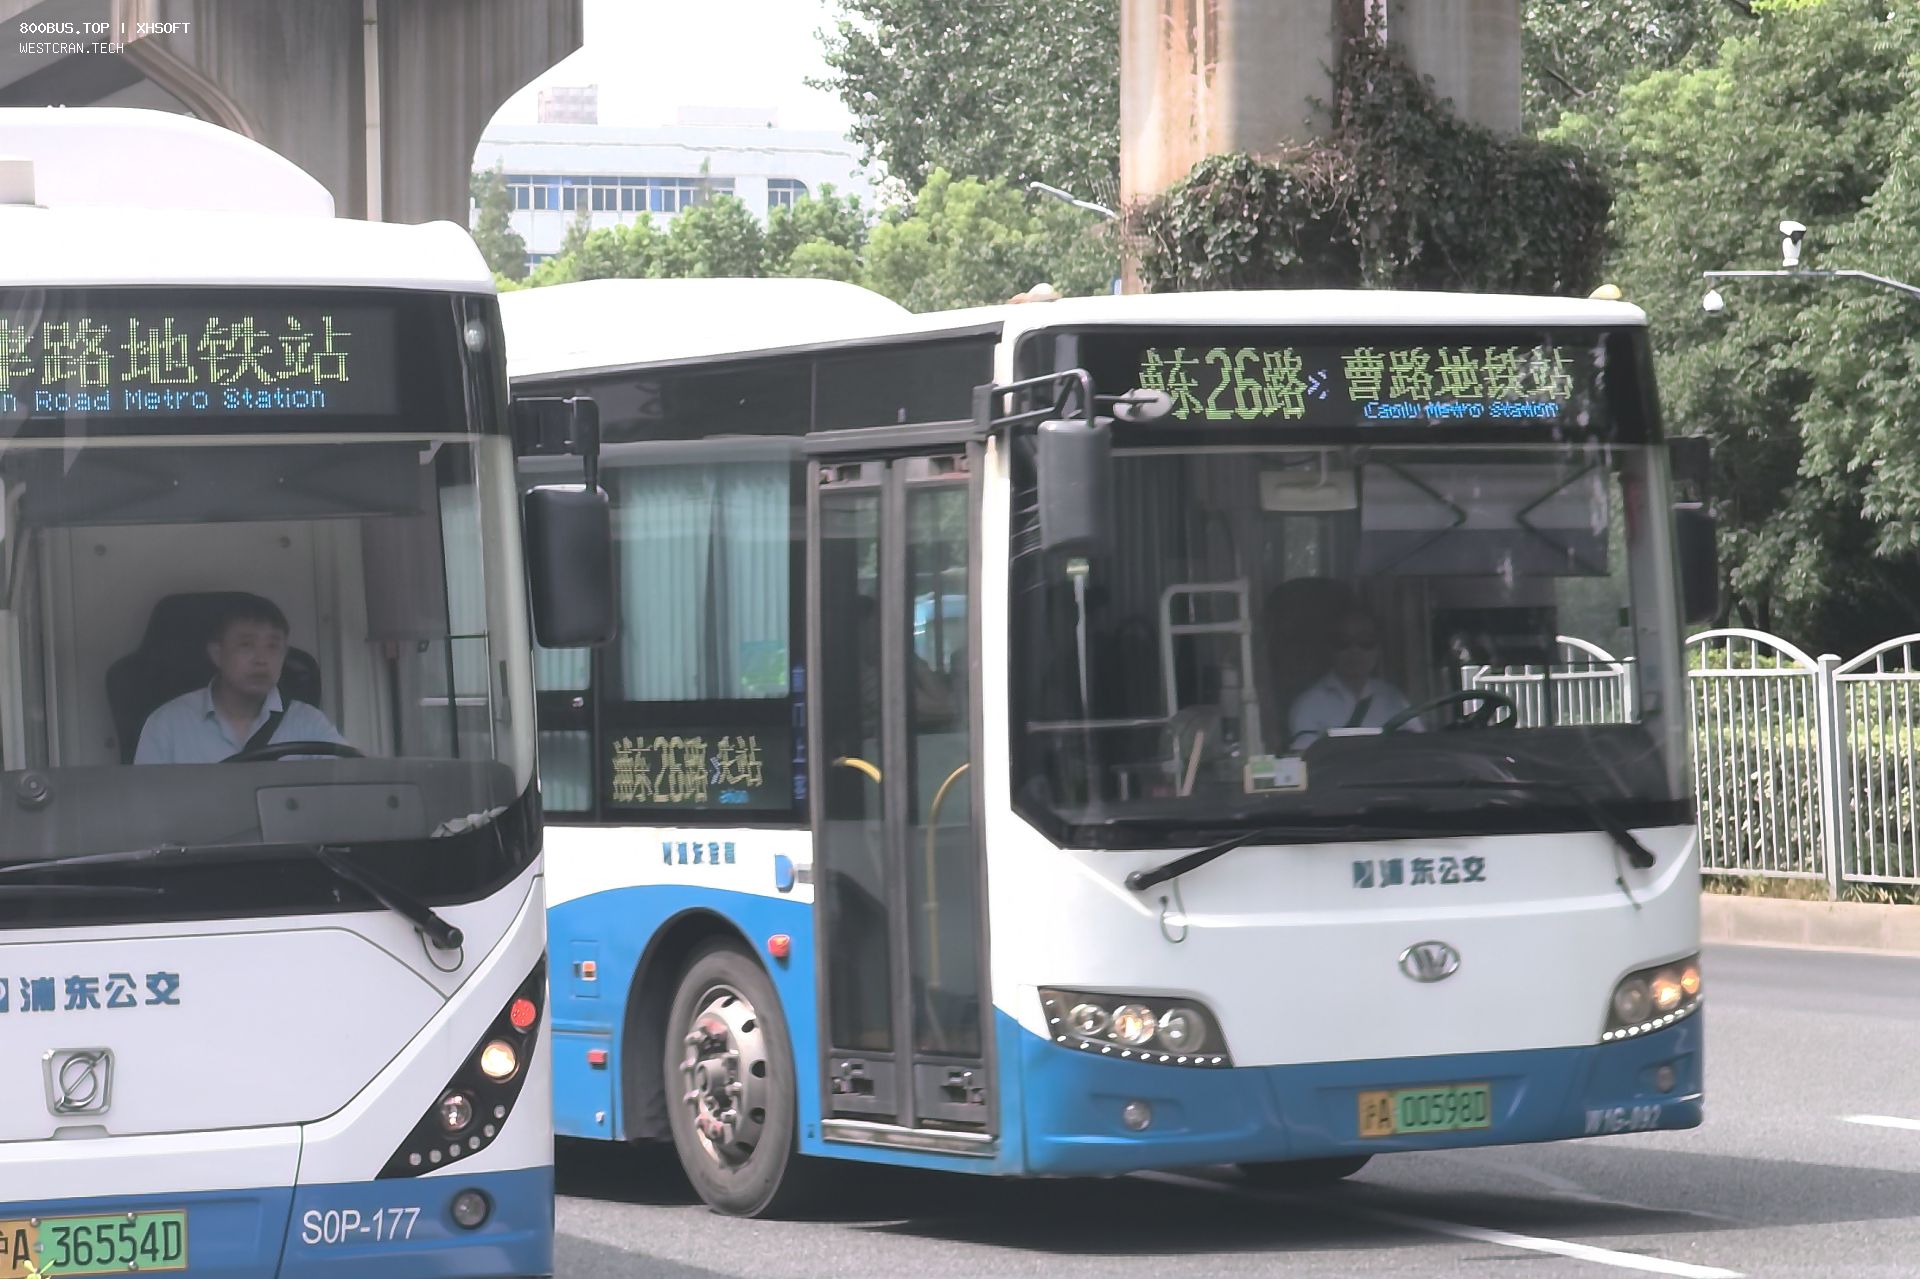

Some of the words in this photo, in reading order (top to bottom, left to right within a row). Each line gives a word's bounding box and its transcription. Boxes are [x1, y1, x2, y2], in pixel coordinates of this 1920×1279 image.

[1341, 346, 1575, 401] 曹路地铁站
[35, 390, 111, 411] Road
[125, 389, 209, 411] Metro
[223, 387, 326, 409] Station
[1424, 401, 1484, 418] Metro
[1489, 400, 1560, 418] Station
[20, 971, 181, 1012] 浦东公交
[52, 1220, 182, 1268] 36554D
